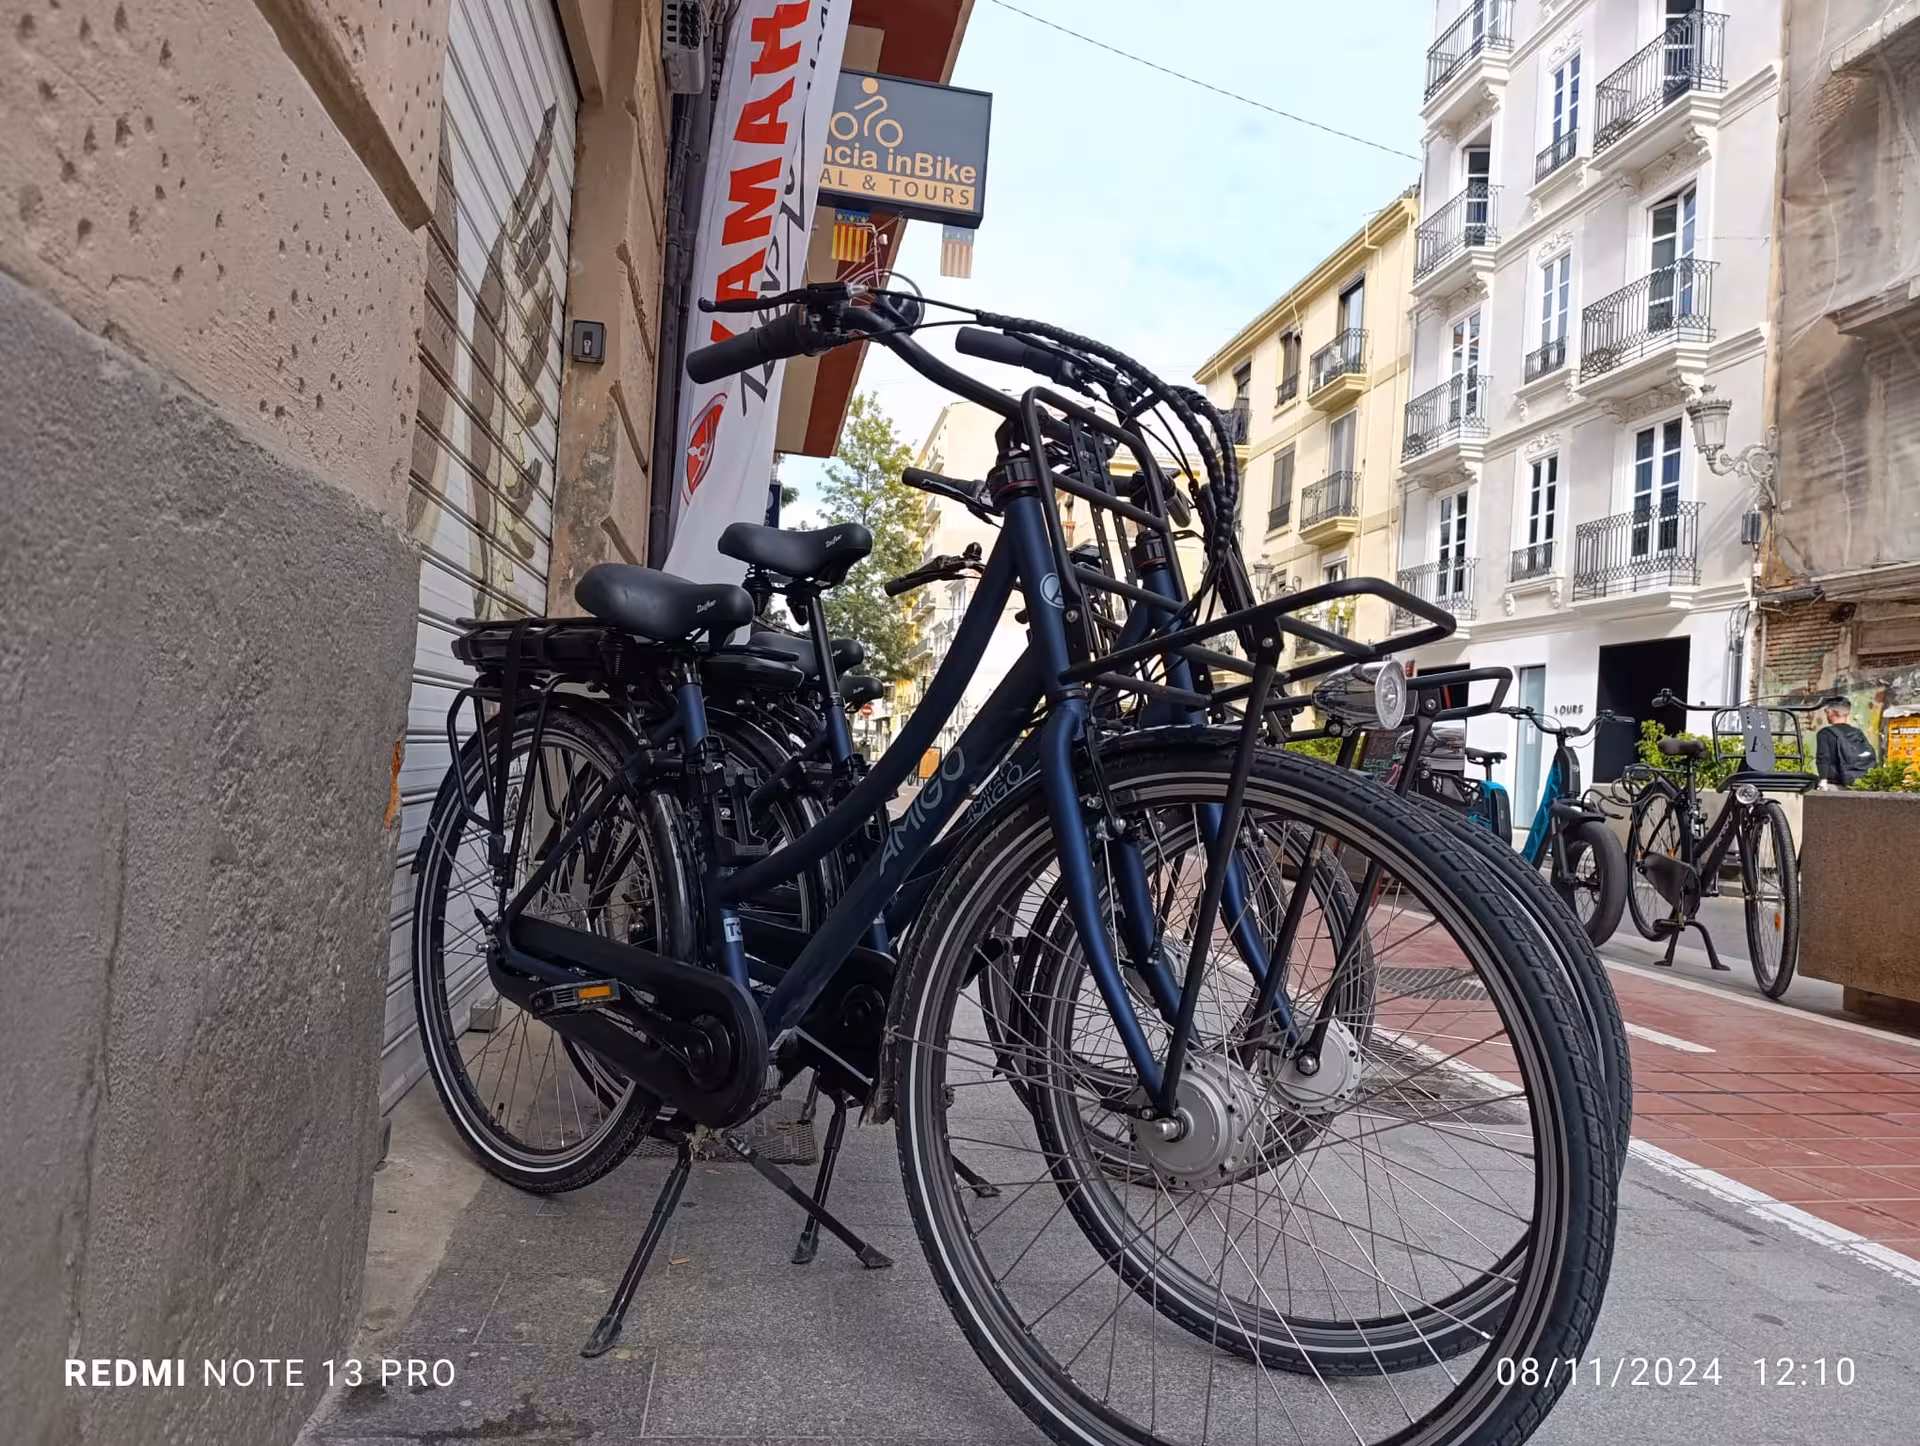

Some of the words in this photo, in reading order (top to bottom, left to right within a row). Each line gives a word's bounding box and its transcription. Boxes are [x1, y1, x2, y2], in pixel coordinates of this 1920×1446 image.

[887, 148, 977, 184] inBike
[862, 174, 876, 191] &
[889, 178, 970, 205] TOURS
[879, 746, 966, 877] AMIGO
